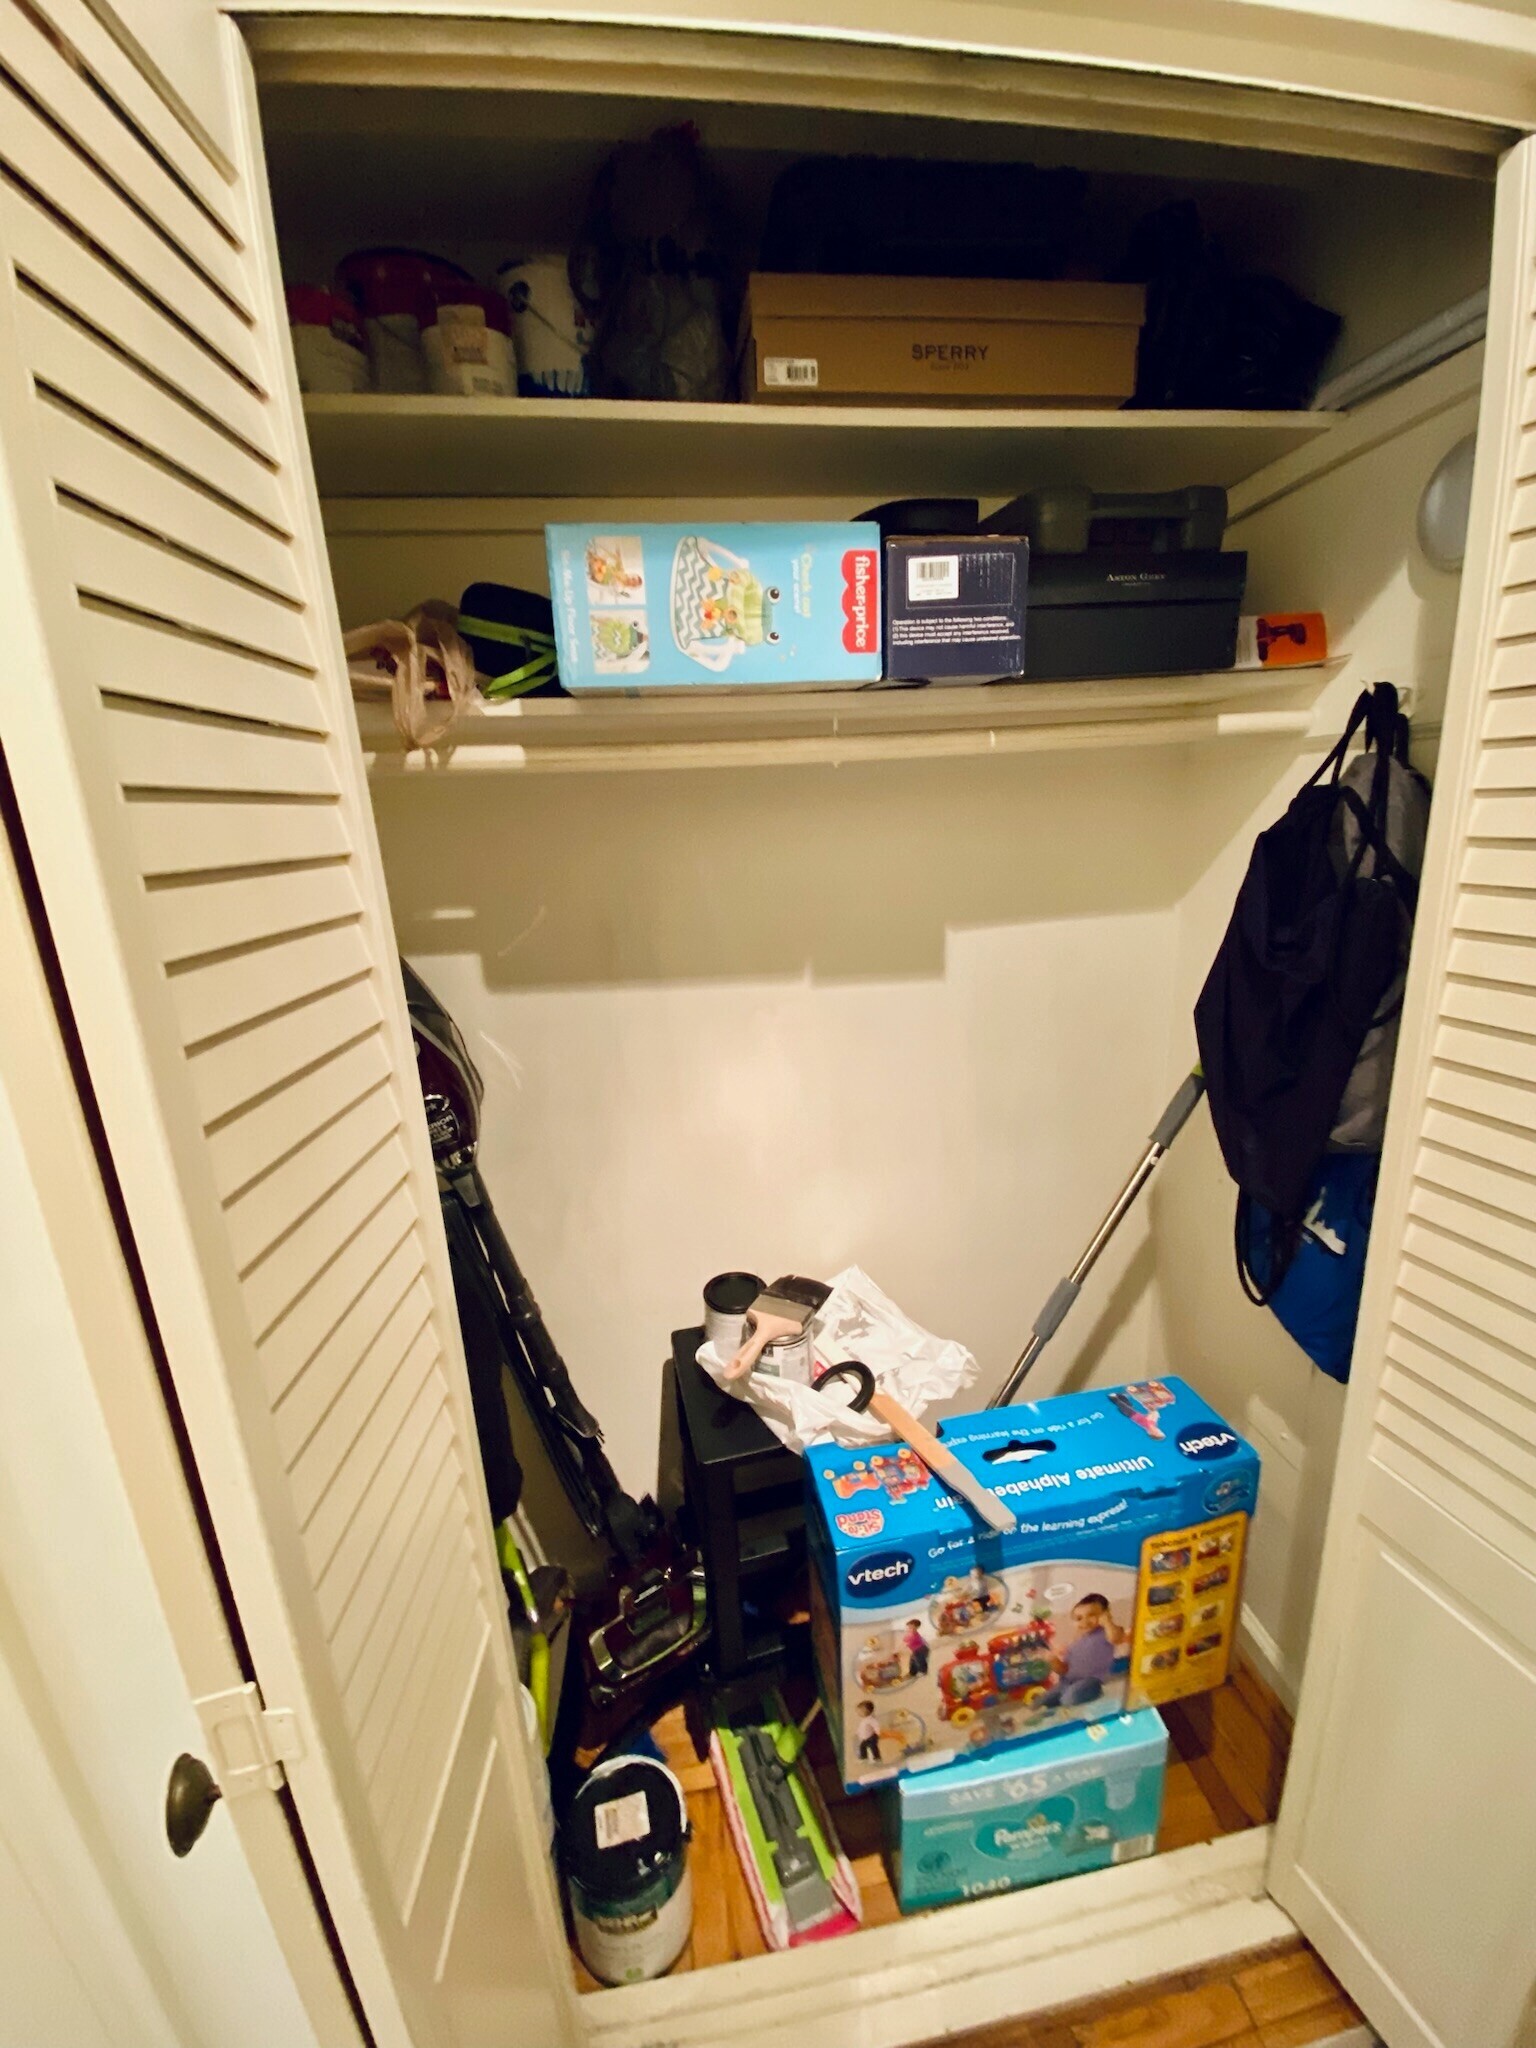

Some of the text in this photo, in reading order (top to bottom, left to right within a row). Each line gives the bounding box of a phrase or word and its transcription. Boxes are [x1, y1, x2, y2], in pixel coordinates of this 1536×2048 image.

[911, 343, 989, 361] SPERRY
[566, 607, 577, 636] Floor
[569, 637, 580, 664] Seat
[1077, 1416, 1092, 1427] for
[1090, 1411, 1105, 1421] Go
[968, 1430, 1010, 1442] learning
[1012, 1428, 1030, 1437] the
[1031, 1427, 1045, 1435] on
[1047, 1423, 1067, 1432] ride
[1179, 1432, 1236, 1455] vtech
[1075, 1455, 1155, 1480] Ultimate
[836, 1509, 881, 1527] Stand
[928, 1546, 945, 1559] Go
[947, 1538, 964, 1551] for
[967, 1535, 976, 1544] a
[1003, 1525, 1018, 1535] on
[1020, 1522, 1040, 1534] the
[1041, 1517, 1086, 1532] learning
[1086, 1498, 1129, 1525] express!
[847, 1560, 909, 1586] vtech
